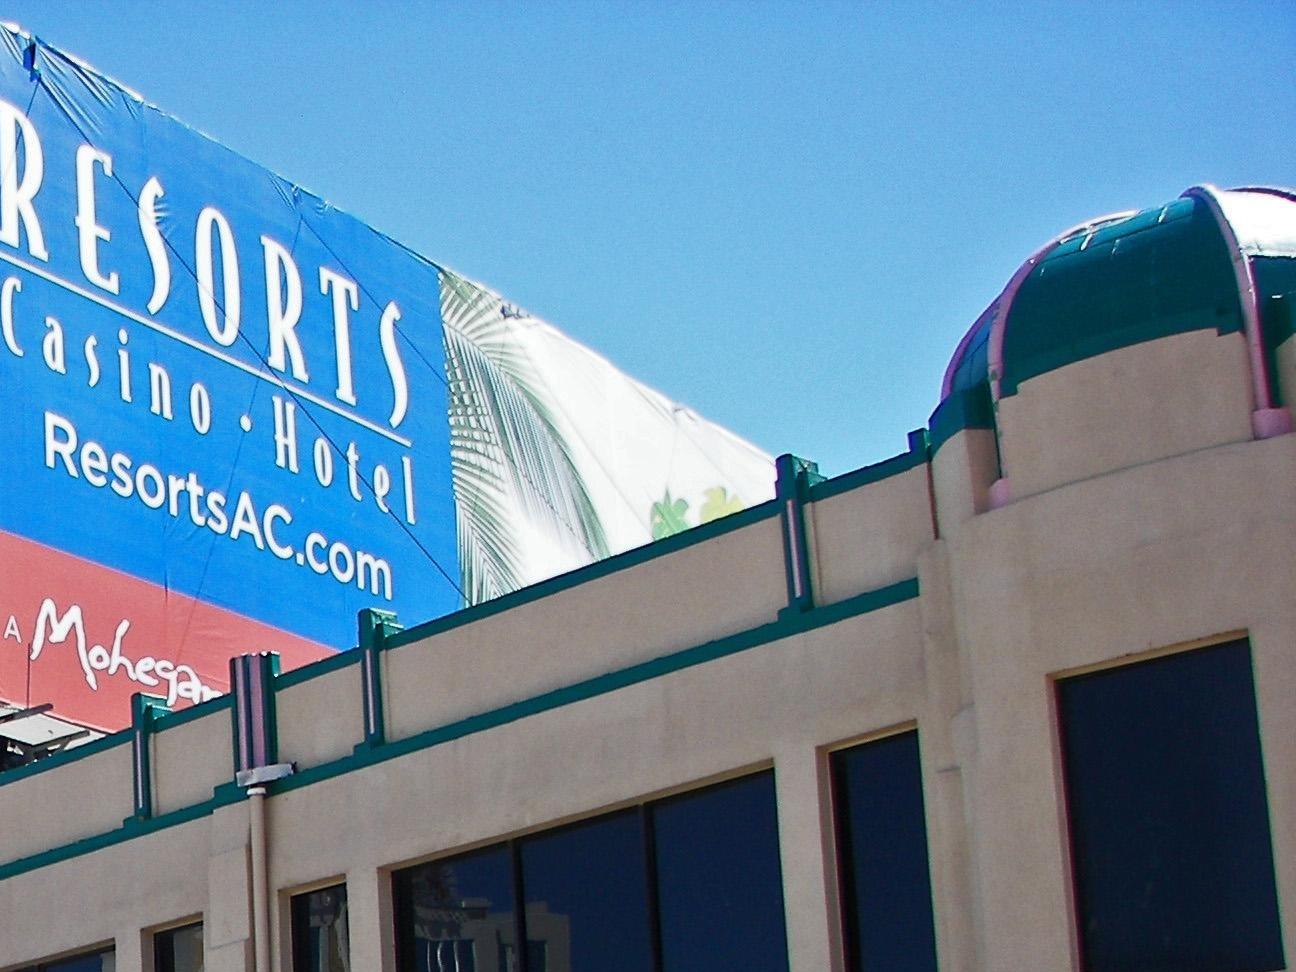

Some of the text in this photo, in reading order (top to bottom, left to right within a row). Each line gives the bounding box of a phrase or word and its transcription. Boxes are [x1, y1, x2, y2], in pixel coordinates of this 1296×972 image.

[1, 277, 416, 525] Casino Hotel
[44, 411, 393, 600] ResortsAC.com
[3, 615, 23, 643] A
